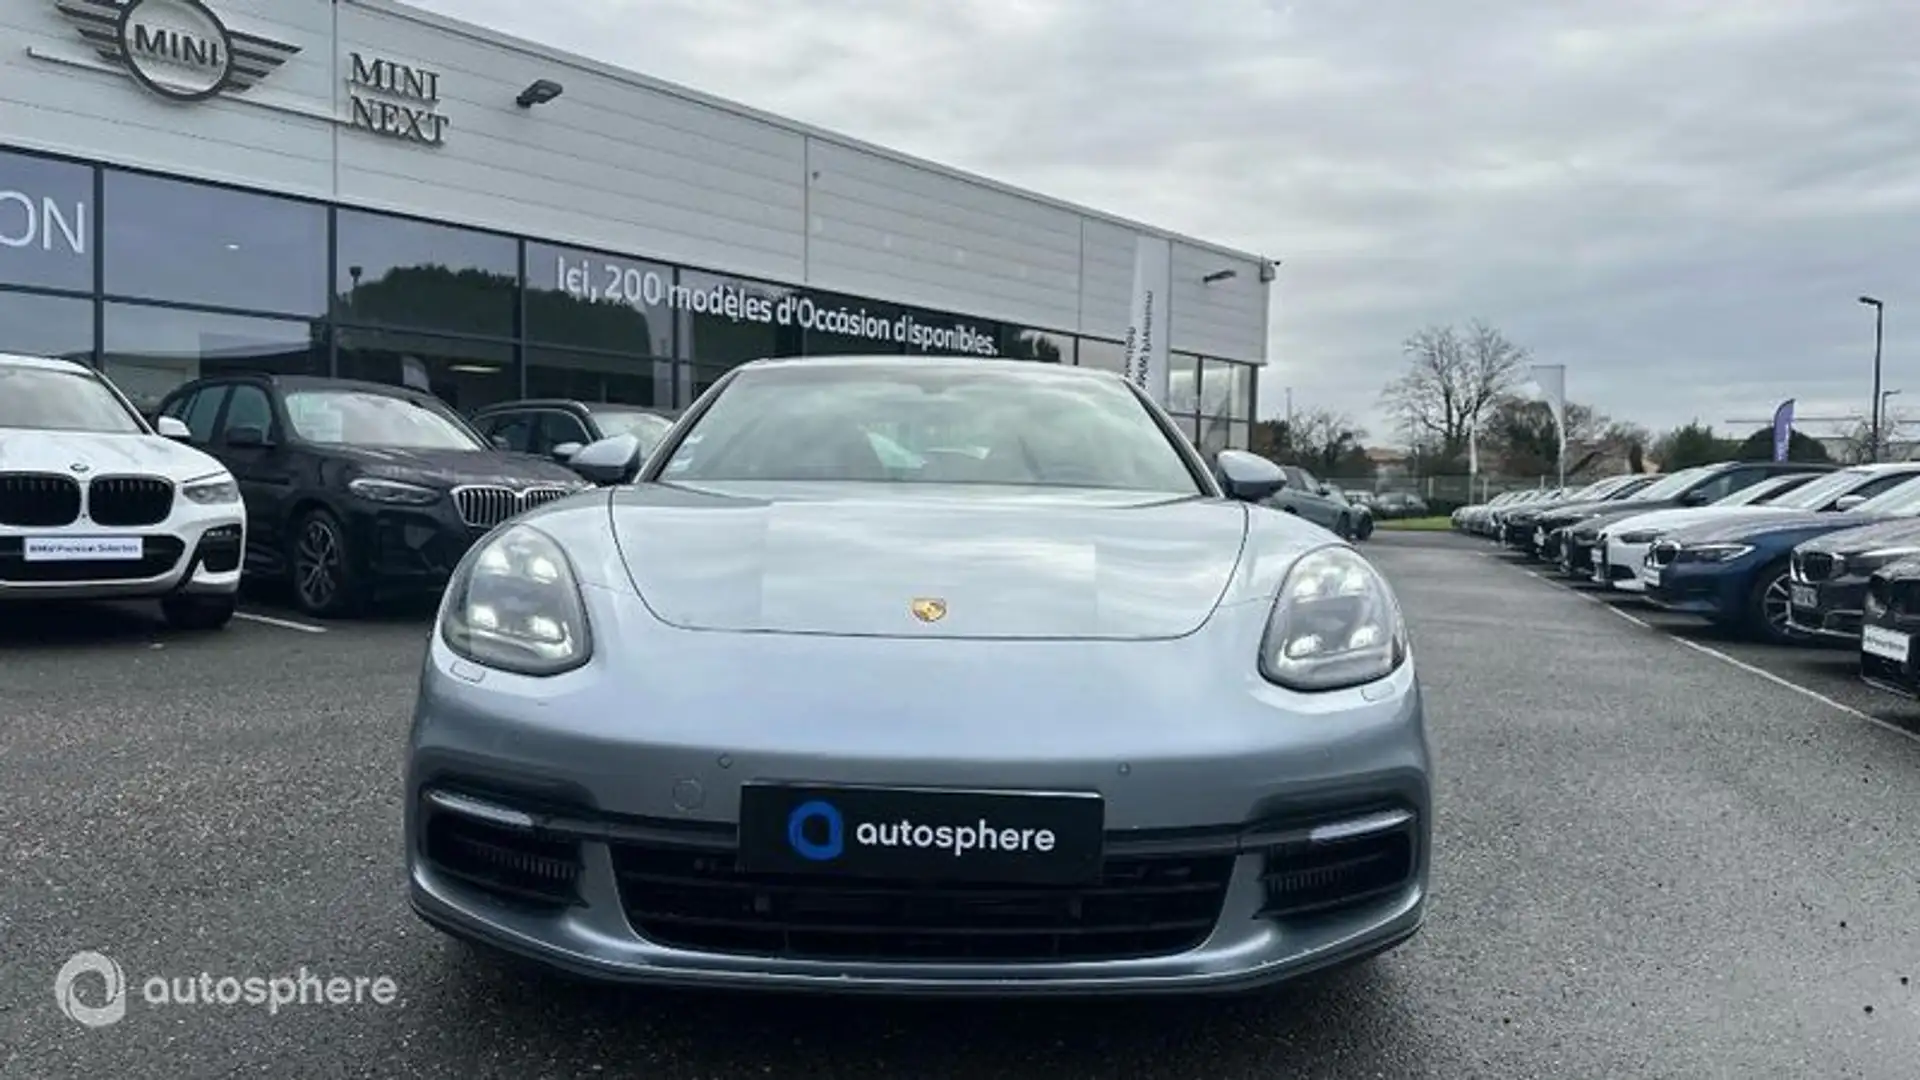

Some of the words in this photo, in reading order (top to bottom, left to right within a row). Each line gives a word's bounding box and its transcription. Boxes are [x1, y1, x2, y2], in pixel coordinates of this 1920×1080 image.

[133, 23, 220, 68] MINI
[350, 52, 440, 102] MINI
[351, 95, 449, 146] NEXT
[604, 264, 661, 306] 200
[667, 284, 773, 324] modèles
[893, 315, 999, 356] disponibles.
[856, 819, 1056, 857] autosphere
